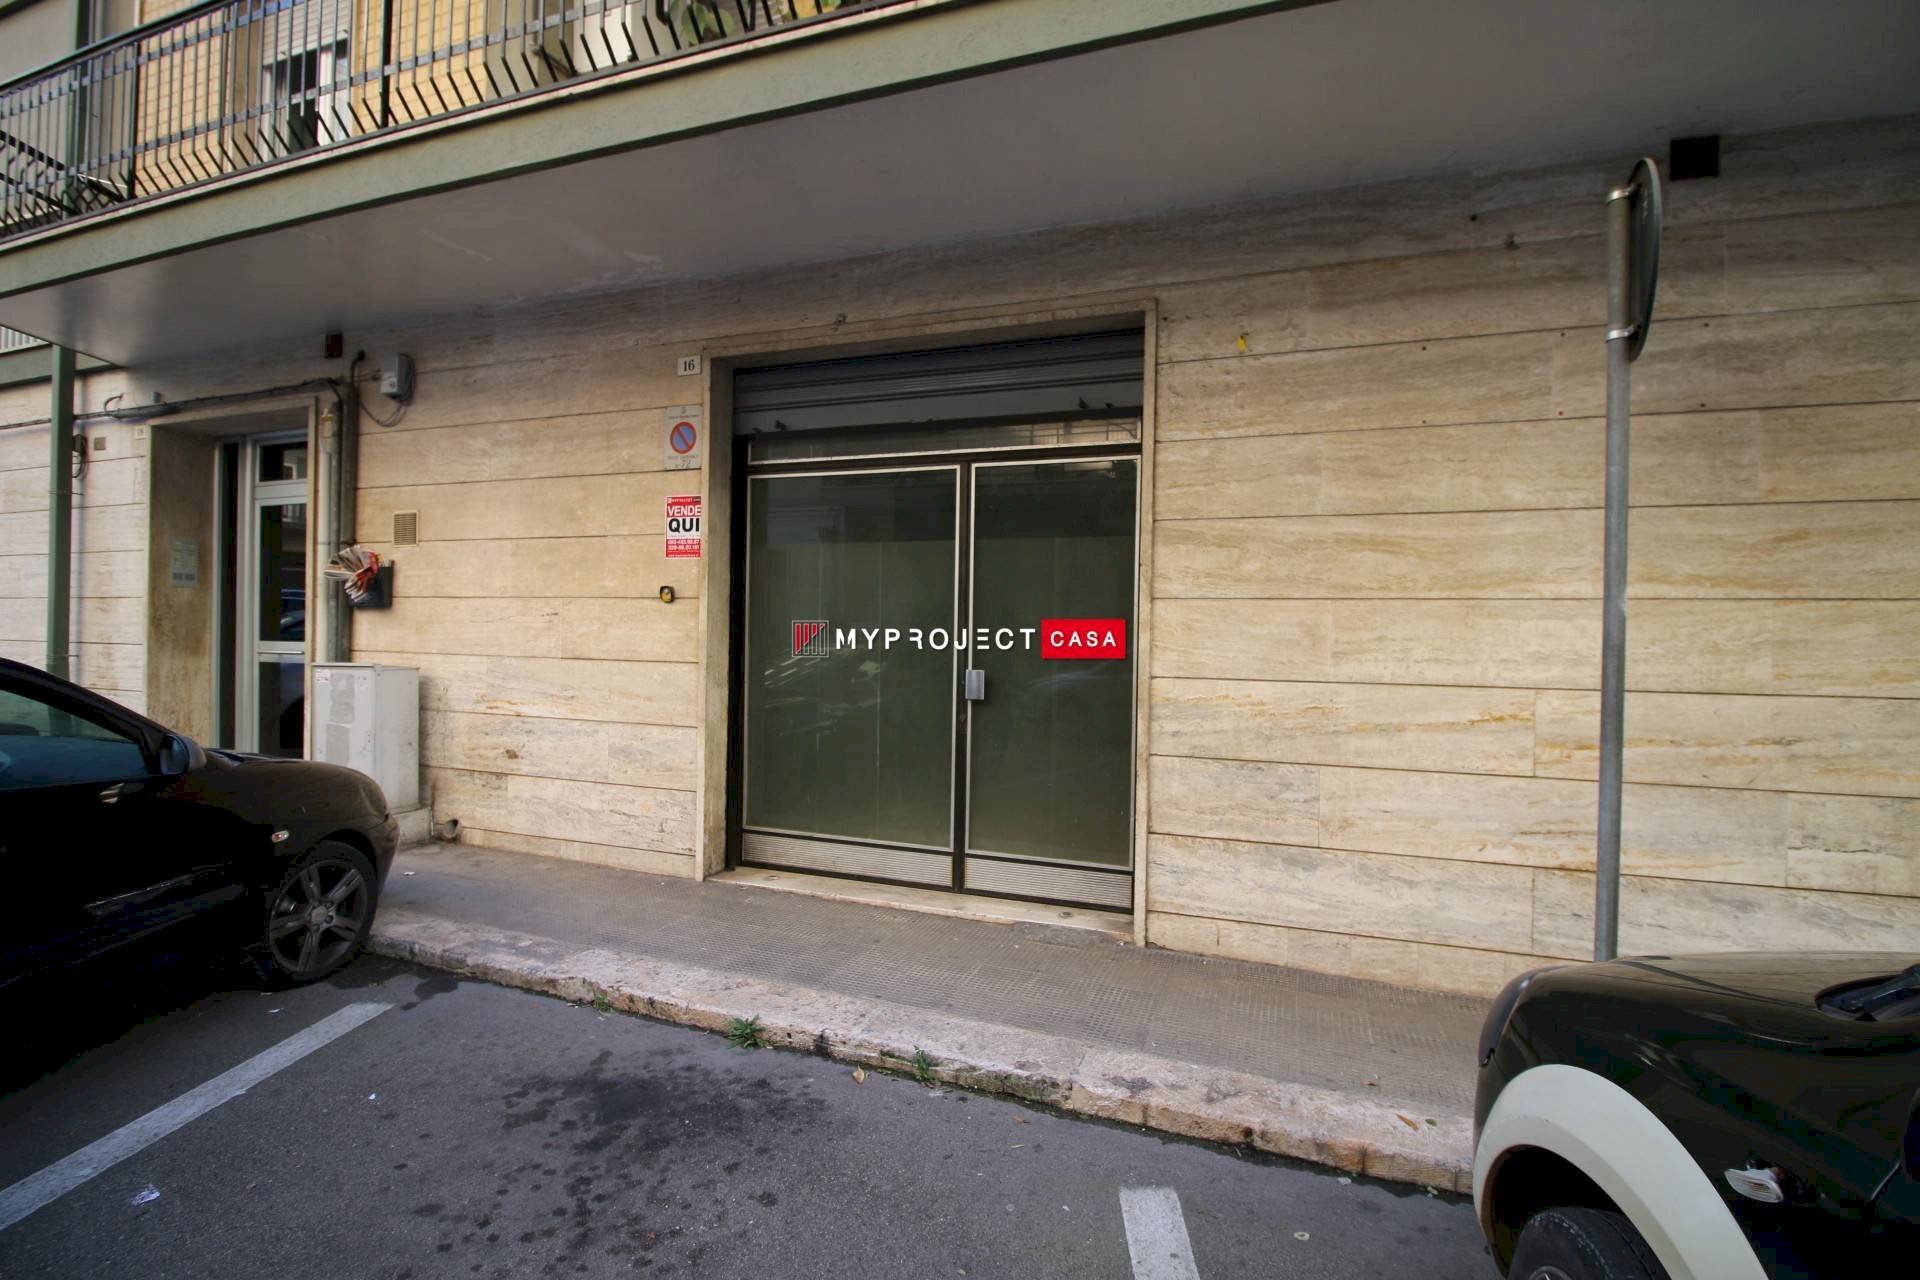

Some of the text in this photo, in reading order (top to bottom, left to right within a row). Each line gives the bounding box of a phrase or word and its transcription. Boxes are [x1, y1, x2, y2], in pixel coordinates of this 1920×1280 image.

[684, 359, 695, 372] 16
[668, 505, 701, 517] VENDE
[668, 518, 700, 533] QUI
